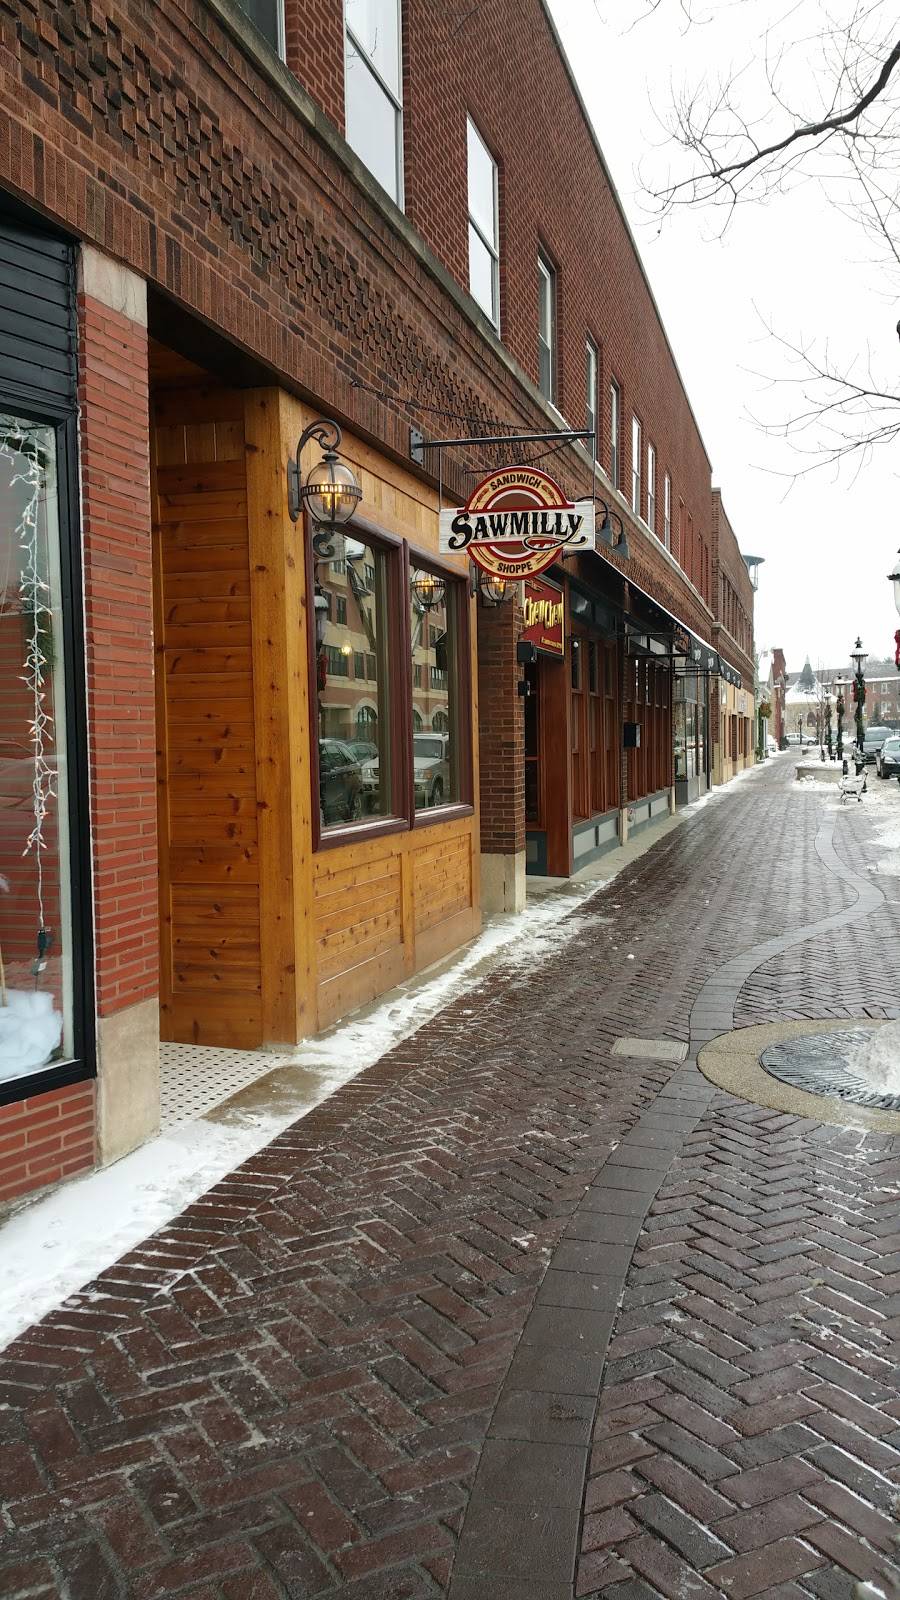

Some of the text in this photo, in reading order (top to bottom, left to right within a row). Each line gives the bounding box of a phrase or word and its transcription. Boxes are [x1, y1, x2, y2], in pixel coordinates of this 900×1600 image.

[490, 473, 542, 491] SANDWICH
[448, 511, 587, 551] SAWMILLY
[497, 561, 533, 574] SHOPPE
